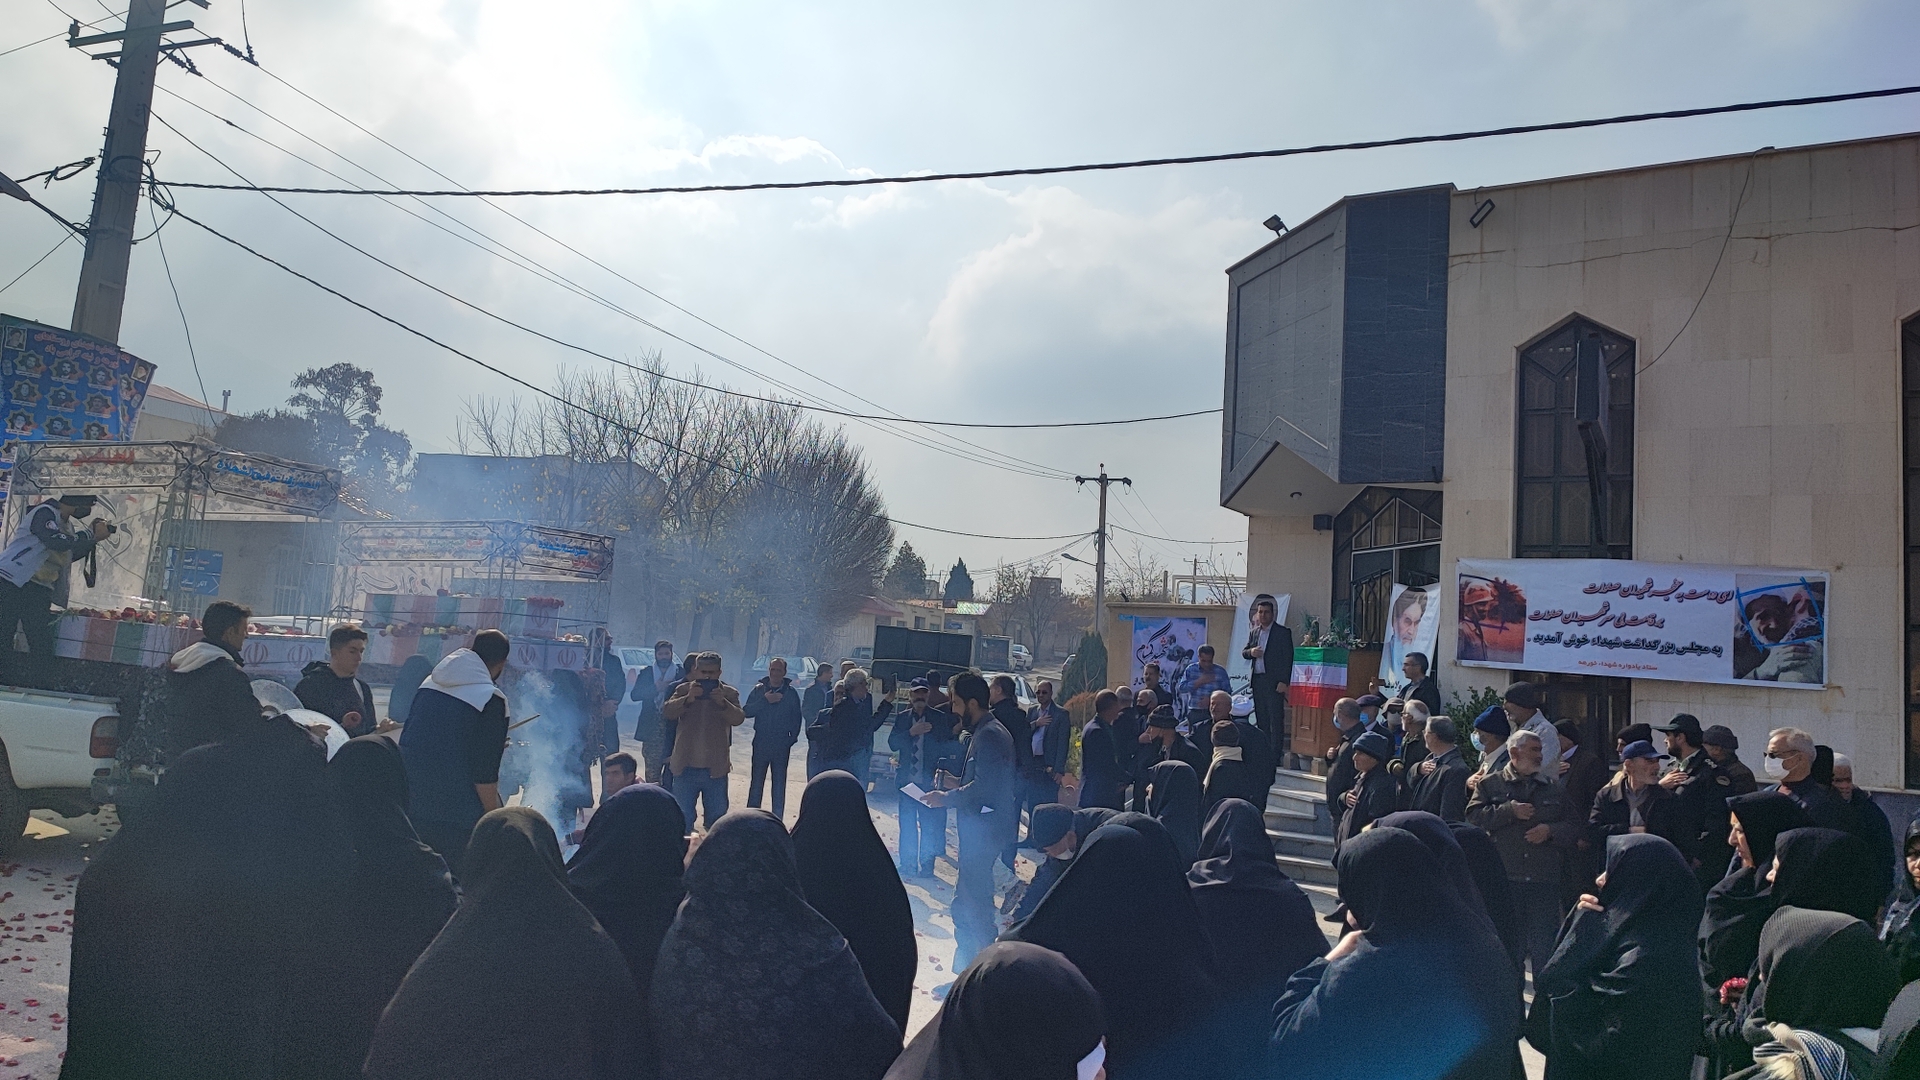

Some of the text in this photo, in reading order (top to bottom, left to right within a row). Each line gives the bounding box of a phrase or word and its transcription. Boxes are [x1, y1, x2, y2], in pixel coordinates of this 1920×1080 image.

[1582, 581, 1621, 594] صلوات
[1618, 577, 1654, 600] شهیدان
[1683, 588, 1719, 600] دوست
[1716, 589, 1734, 604] ای
[1527, 609, 1563, 621] صلوات
[1561, 600, 1611, 627] شهیدان
[1562, 633, 1591, 649] خوش
[1590, 635, 1622, 650] شهداء
[1675, 640, 1711, 656] مجلس
[1711, 643, 1724, 658] به
[1618, 663, 1642, 671] یادواره
